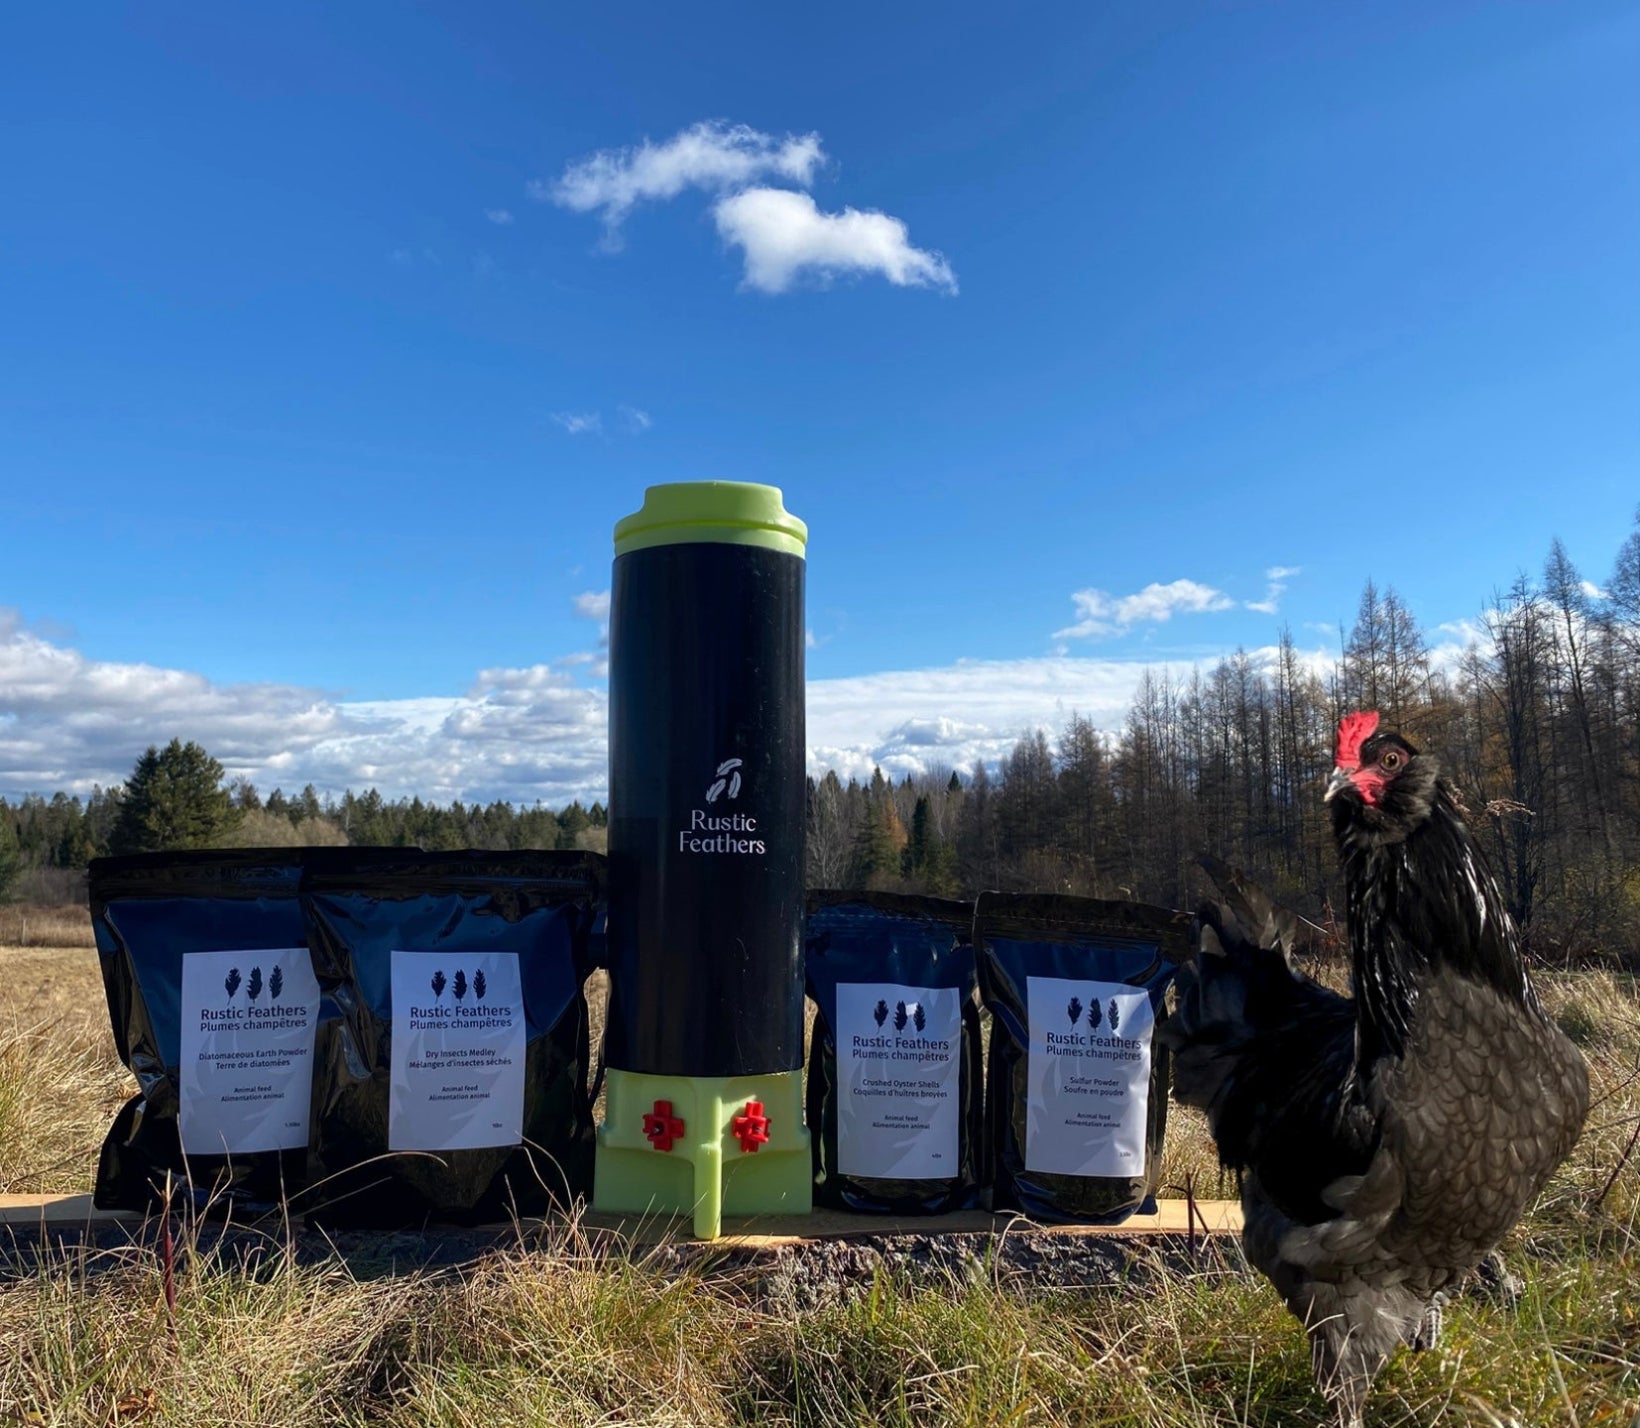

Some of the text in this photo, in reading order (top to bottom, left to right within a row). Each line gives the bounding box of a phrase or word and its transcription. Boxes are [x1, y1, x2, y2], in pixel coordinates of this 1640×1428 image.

[691, 809, 757, 832] Rustic
[679, 831, 766, 855] Feathers
[201, 1005, 307, 1020] Rustic Feathers
[410, 1004, 512, 1018] Rustic Feathers
[200, 1018, 307, 1032] Plumes champêtres
[410, 1017, 512, 1030] Plumes champêtres
[853, 1035, 949, 1050] Rustic Feathers
[1047, 1032, 1142, 1050] Rustic Feathers
[199, 1048, 307, 1061] Diatomaceous Earth Powder
[425, 1048, 496, 1059] Dry Insects Medley
[852, 1049, 949, 1062] Plumes champêtres
[1046, 1045, 1142, 1061] Plumes champêtres
[862, 1078, 940, 1088] Crushed Oyster Shells
[1070, 1076, 1120, 1086] Sulfur Powder
[221, 1094, 262, 1102] Alimentation
